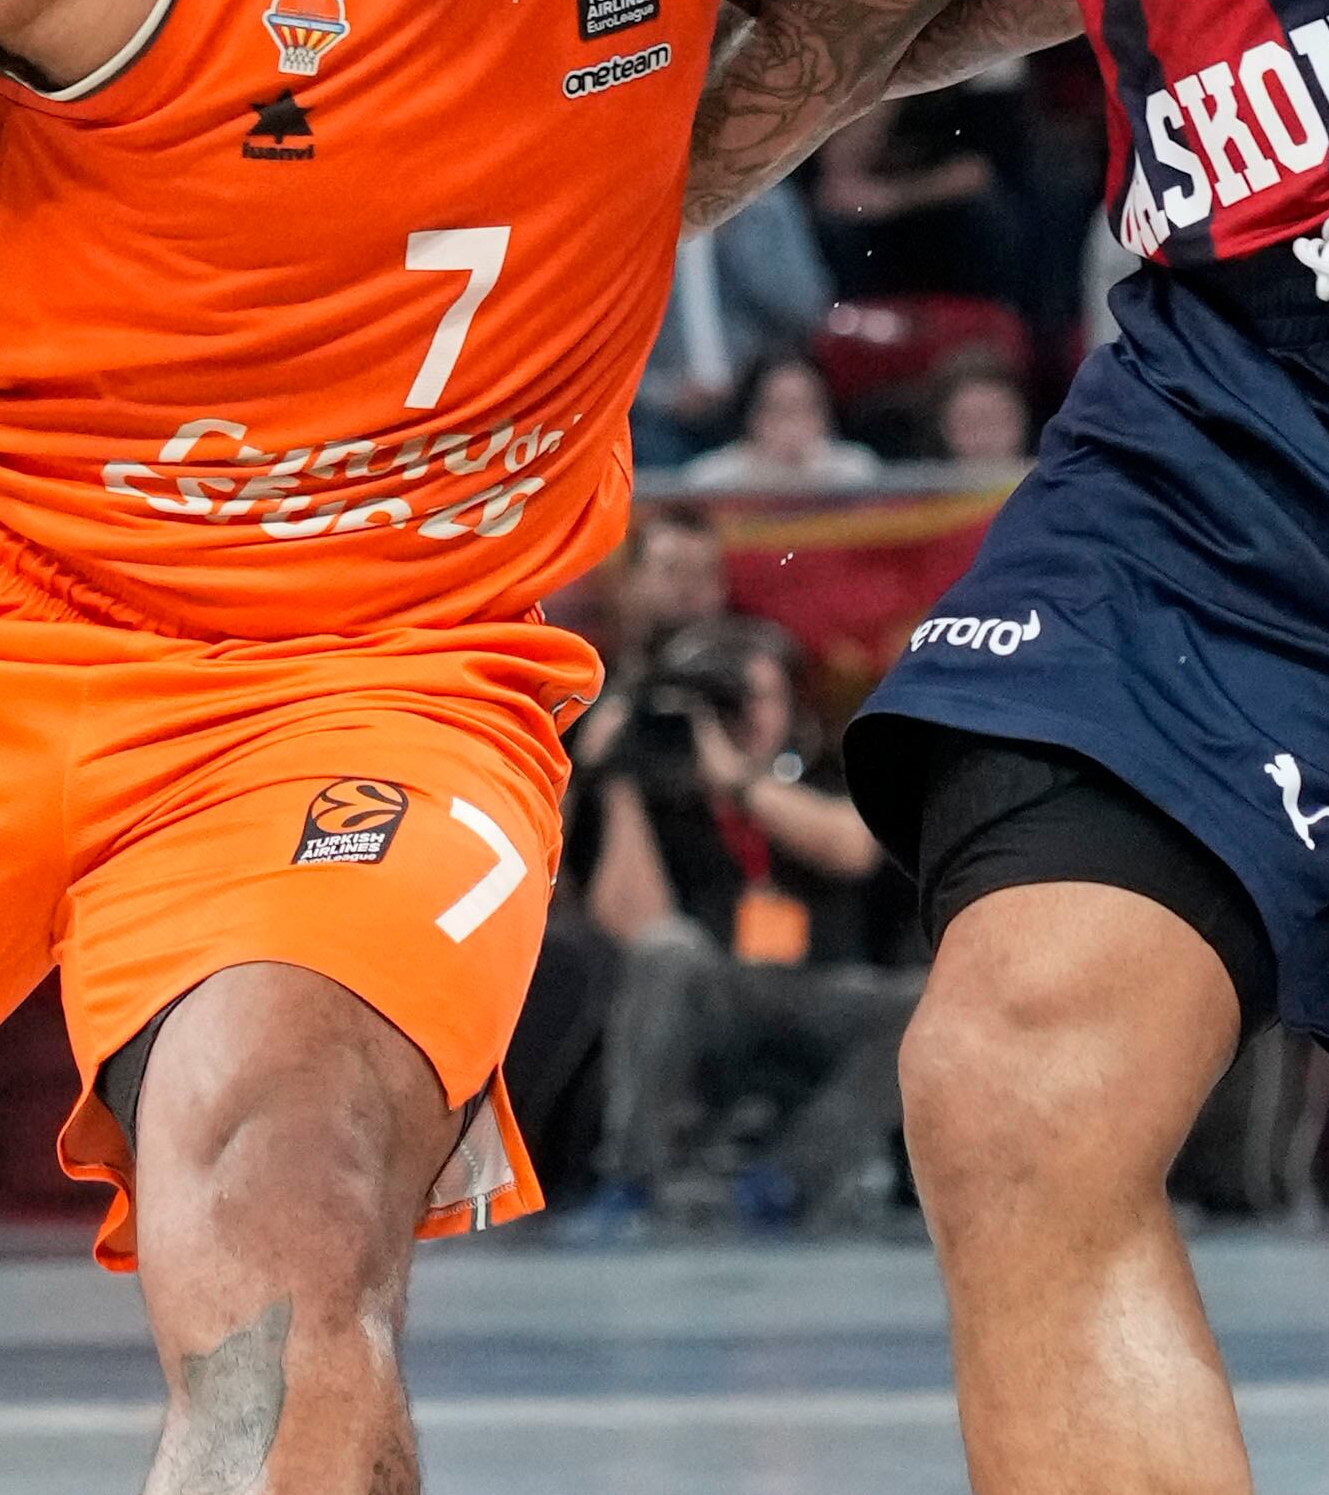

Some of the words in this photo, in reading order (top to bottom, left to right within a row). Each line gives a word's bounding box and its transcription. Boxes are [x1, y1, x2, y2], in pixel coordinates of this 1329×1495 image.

[586, 3, 655, 34] EuroLeague
[565, 45, 669, 96] oneteam
[404, 225, 512, 409] 7
[300, 843, 381, 860] AIRLINES
[306, 833, 385, 850] TURKISH
[434, 795, 528, 945] 7
